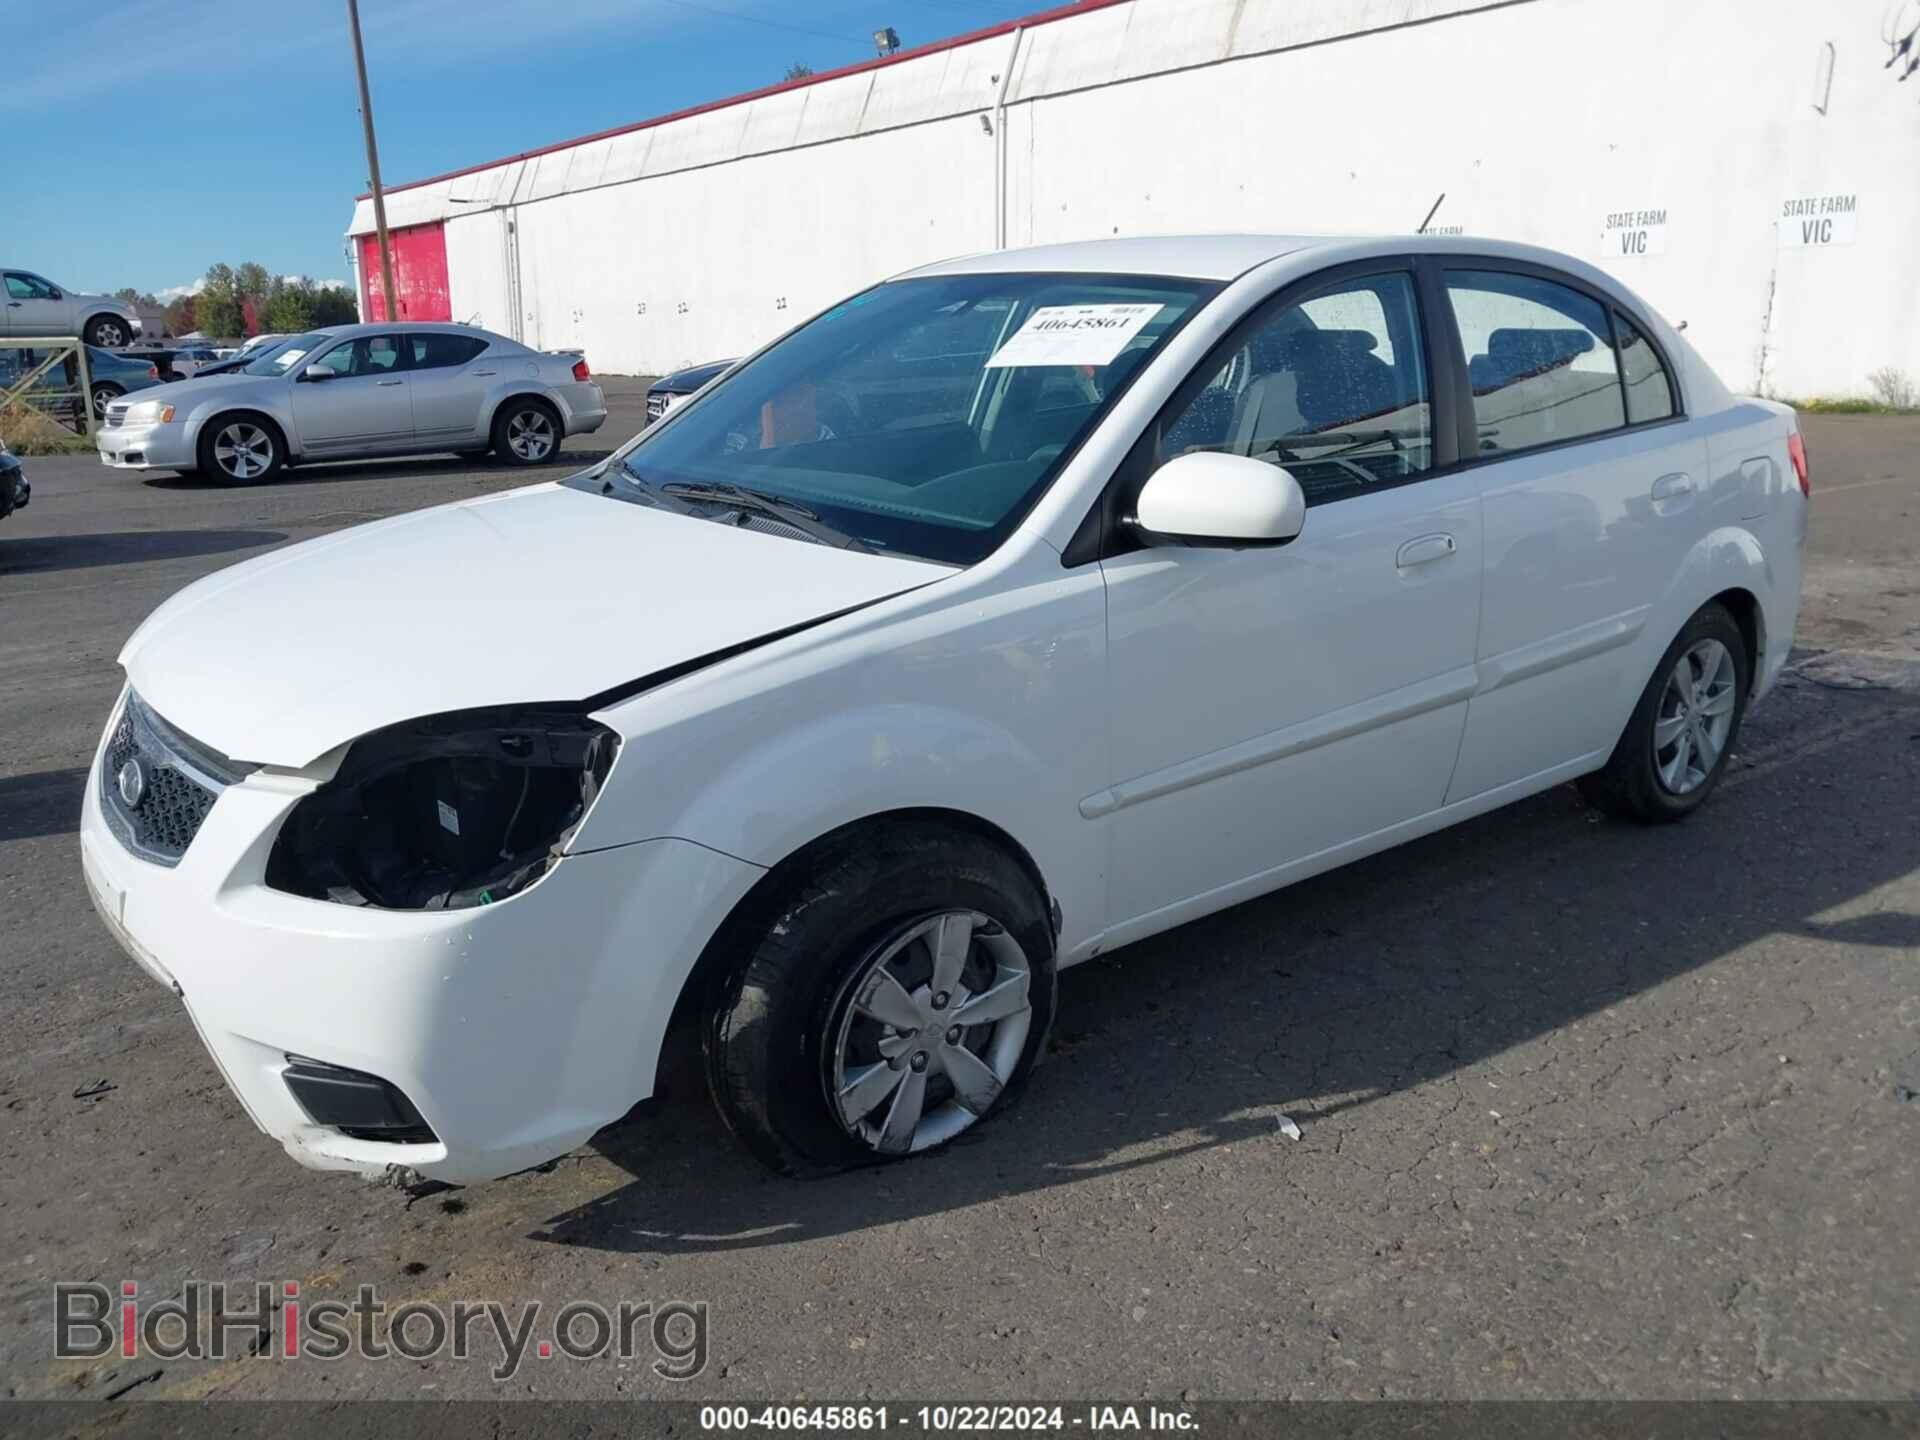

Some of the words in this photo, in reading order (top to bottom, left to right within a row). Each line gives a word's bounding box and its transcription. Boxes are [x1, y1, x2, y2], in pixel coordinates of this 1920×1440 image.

[1783, 199, 1816, 217] STATE
[1820, 196, 1856, 214] FARM
[1606, 213, 1633, 229] STATE
[1636, 210, 1667, 225] FARM
[1802, 219, 1832, 244] VIC
[1621, 231, 1647, 254] VIC
[1033, 317, 1131, 331] 40645861
